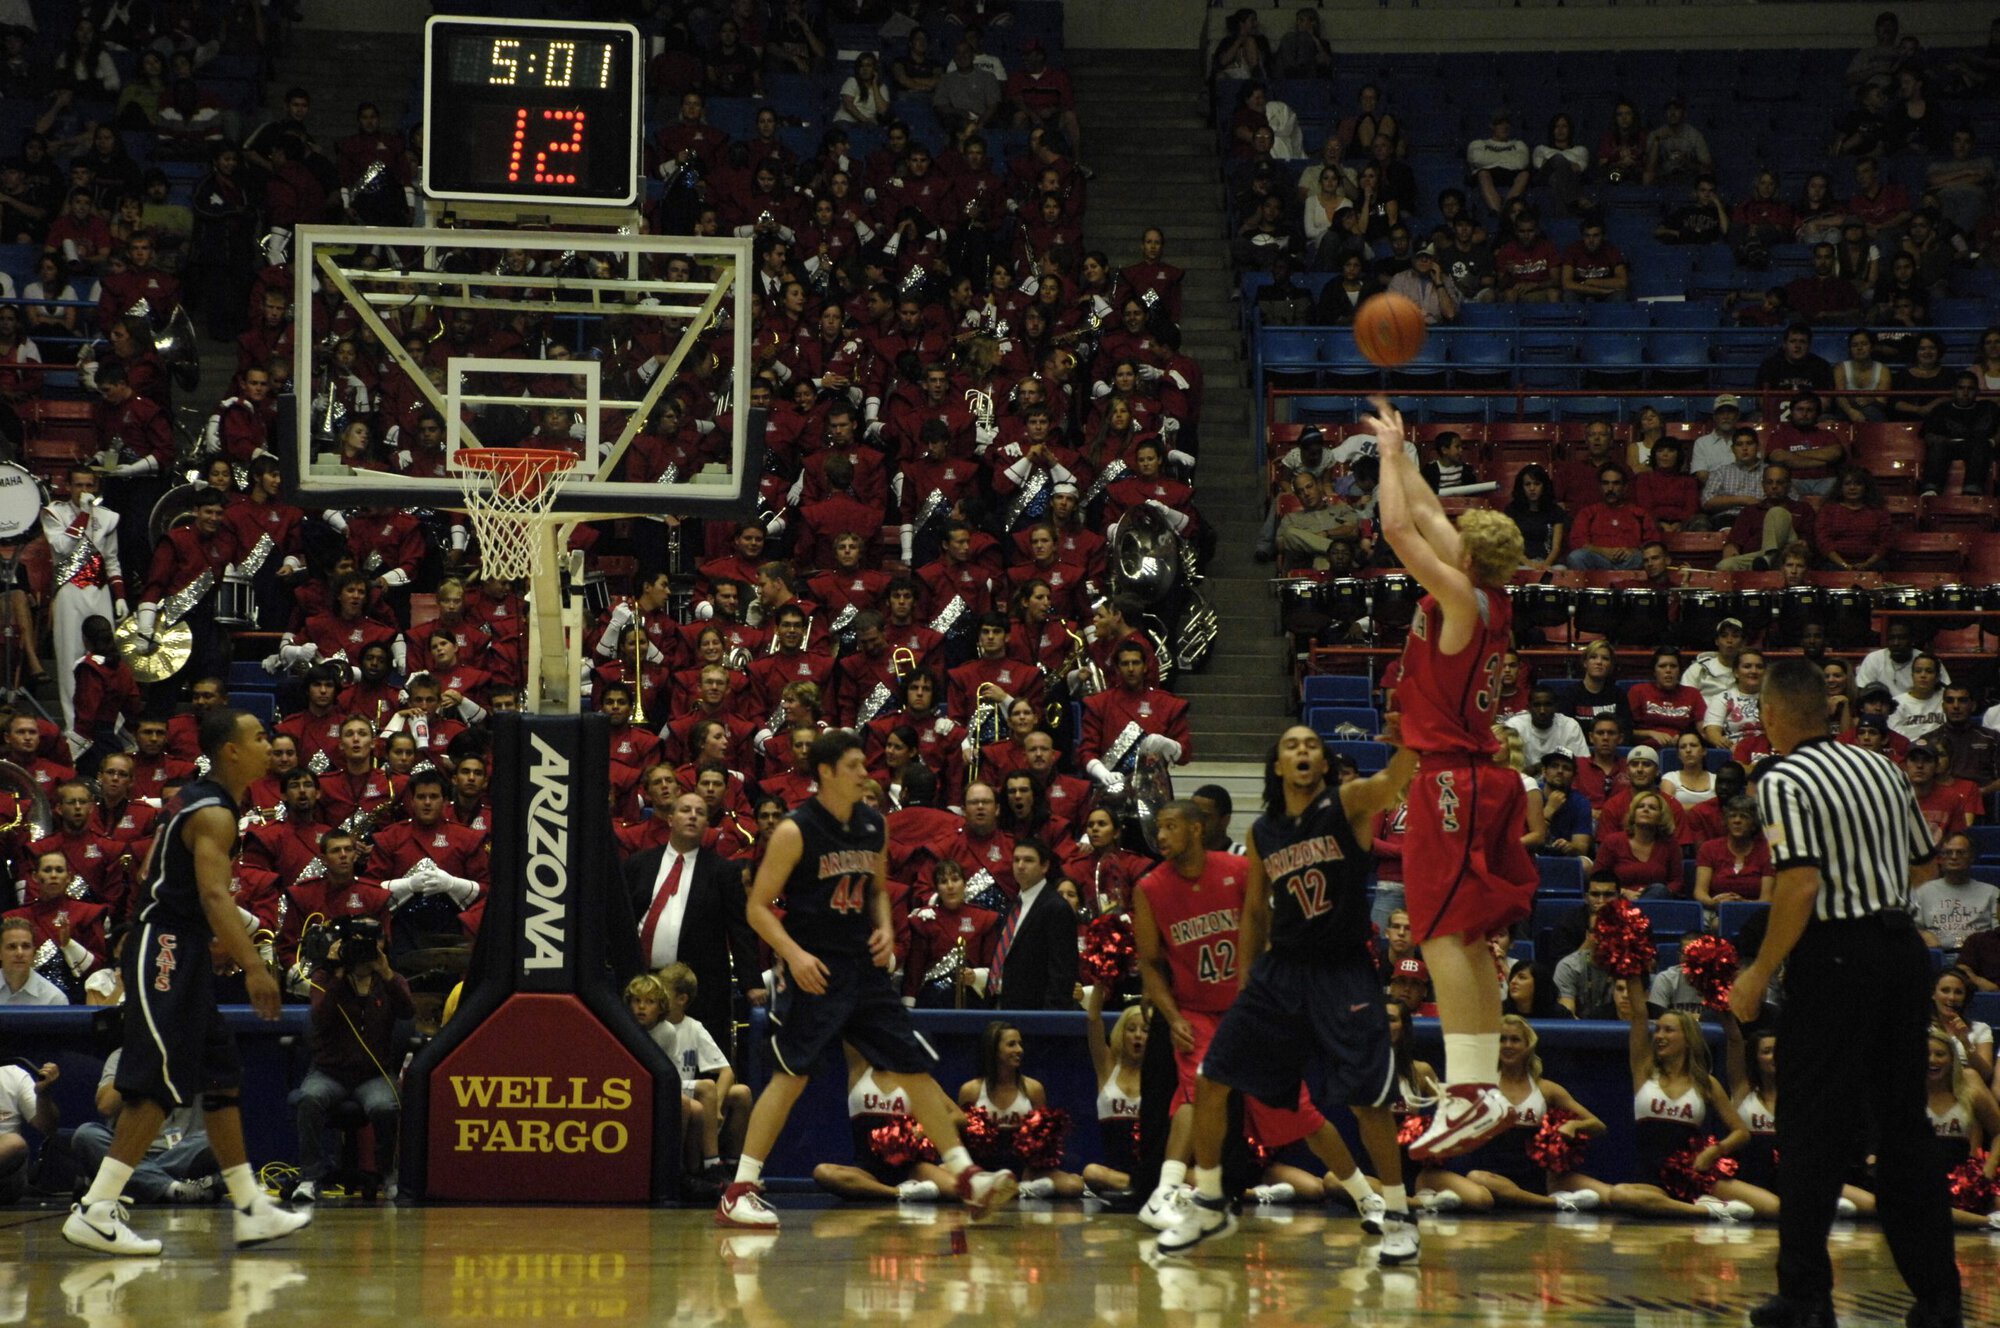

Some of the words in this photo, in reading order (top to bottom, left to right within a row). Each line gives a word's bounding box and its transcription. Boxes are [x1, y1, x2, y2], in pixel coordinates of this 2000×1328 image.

[489, 40, 612, 89] 5:01
[508, 108, 586, 185] 12
[1436, 770, 1461, 832] CATS
[523, 732, 570, 970] ARIZONA
[829, 874, 865, 915] 44
[1286, 867, 1334, 920] 12
[1170, 907, 1240, 946] ARIZON
[153, 933, 178, 992] CATS
[1197, 939, 1237, 984] 42
[449, 1075, 633, 1110] WELLS
[864, 1094, 878, 1109] U
[892, 1096, 904, 1112] A
[1112, 1099, 1125, 1114] U
[1650, 1098, 1666, 1114] U
[1680, 1103, 1693, 1119] A
[453, 1119, 629, 1154] FARGO
[1752, 1113, 1765, 1129] U
